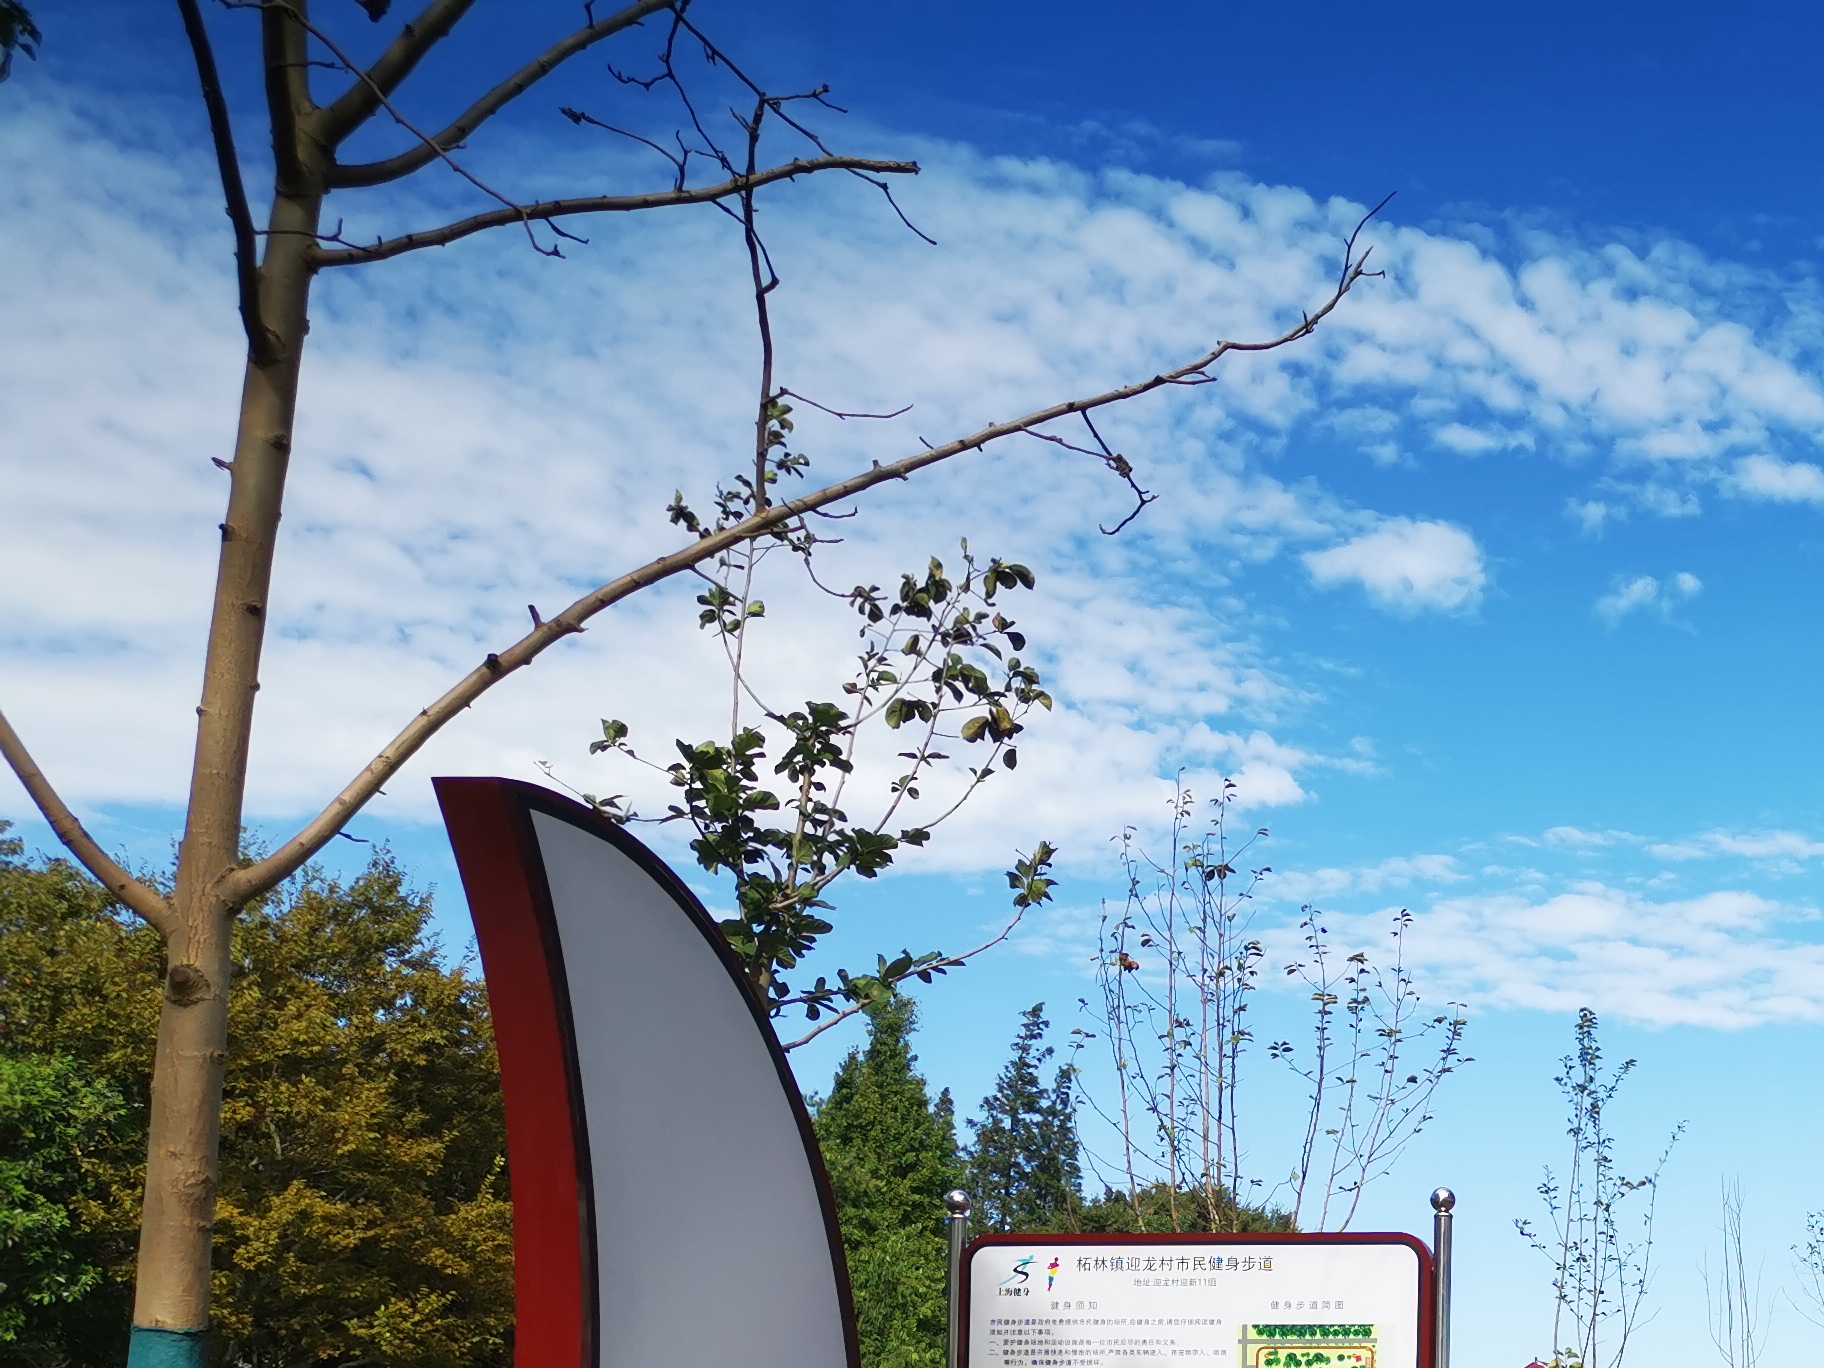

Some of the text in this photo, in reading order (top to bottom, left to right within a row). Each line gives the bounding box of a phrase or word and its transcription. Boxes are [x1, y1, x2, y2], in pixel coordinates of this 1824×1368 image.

[1076, 1256, 1274, 1272] 柘林镇迎龙村市民健身步道
[1050, 1301, 1099, 1310] 健身须知
[1270, 1300, 1344, 1310] 健身步道简图
